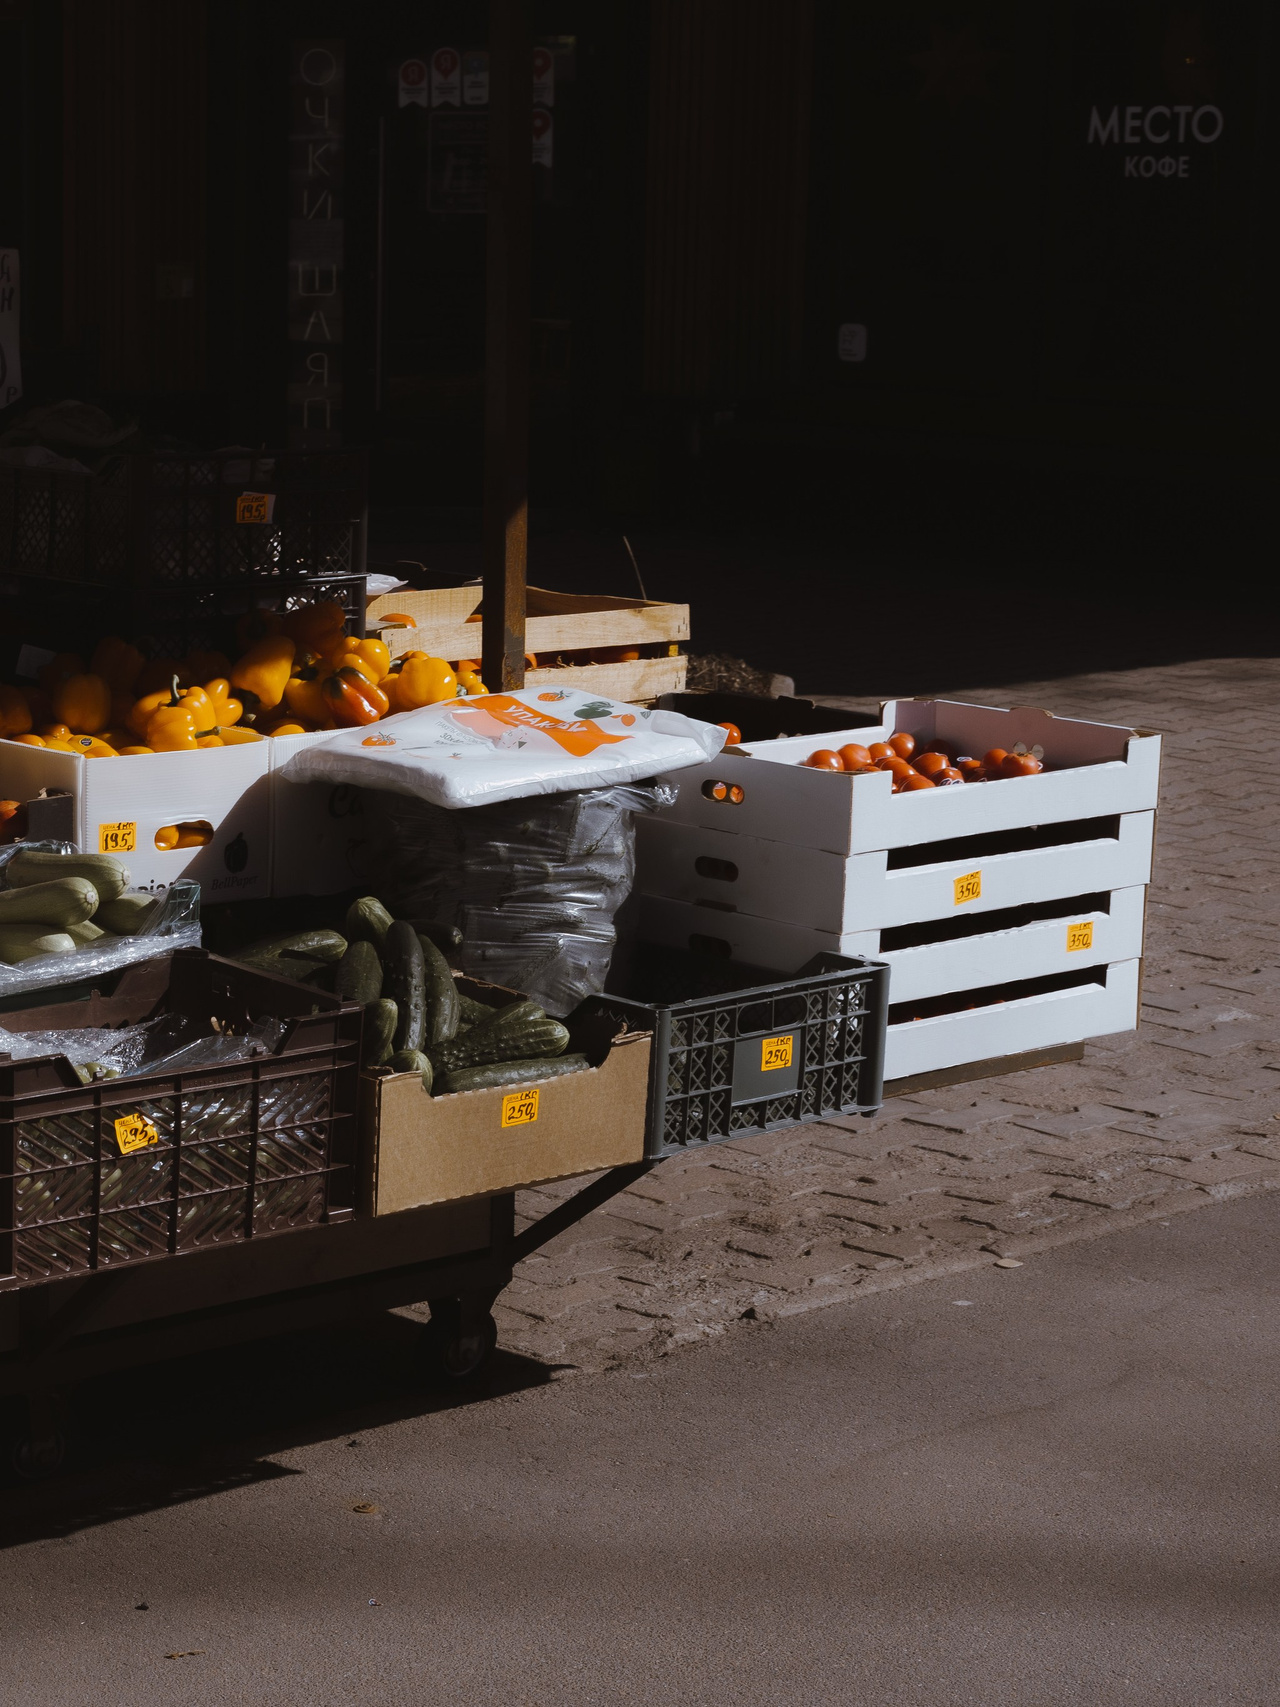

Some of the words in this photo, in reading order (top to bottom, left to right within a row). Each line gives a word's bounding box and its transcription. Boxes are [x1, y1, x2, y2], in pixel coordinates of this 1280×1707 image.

[300, 48, 336, 220] ОЧКИ
[1087, 104, 1224, 146] МЕСТО
[1124, 155, 1190, 178] КОФЕ
[298, 264, 336, 449] ШЛЯП
